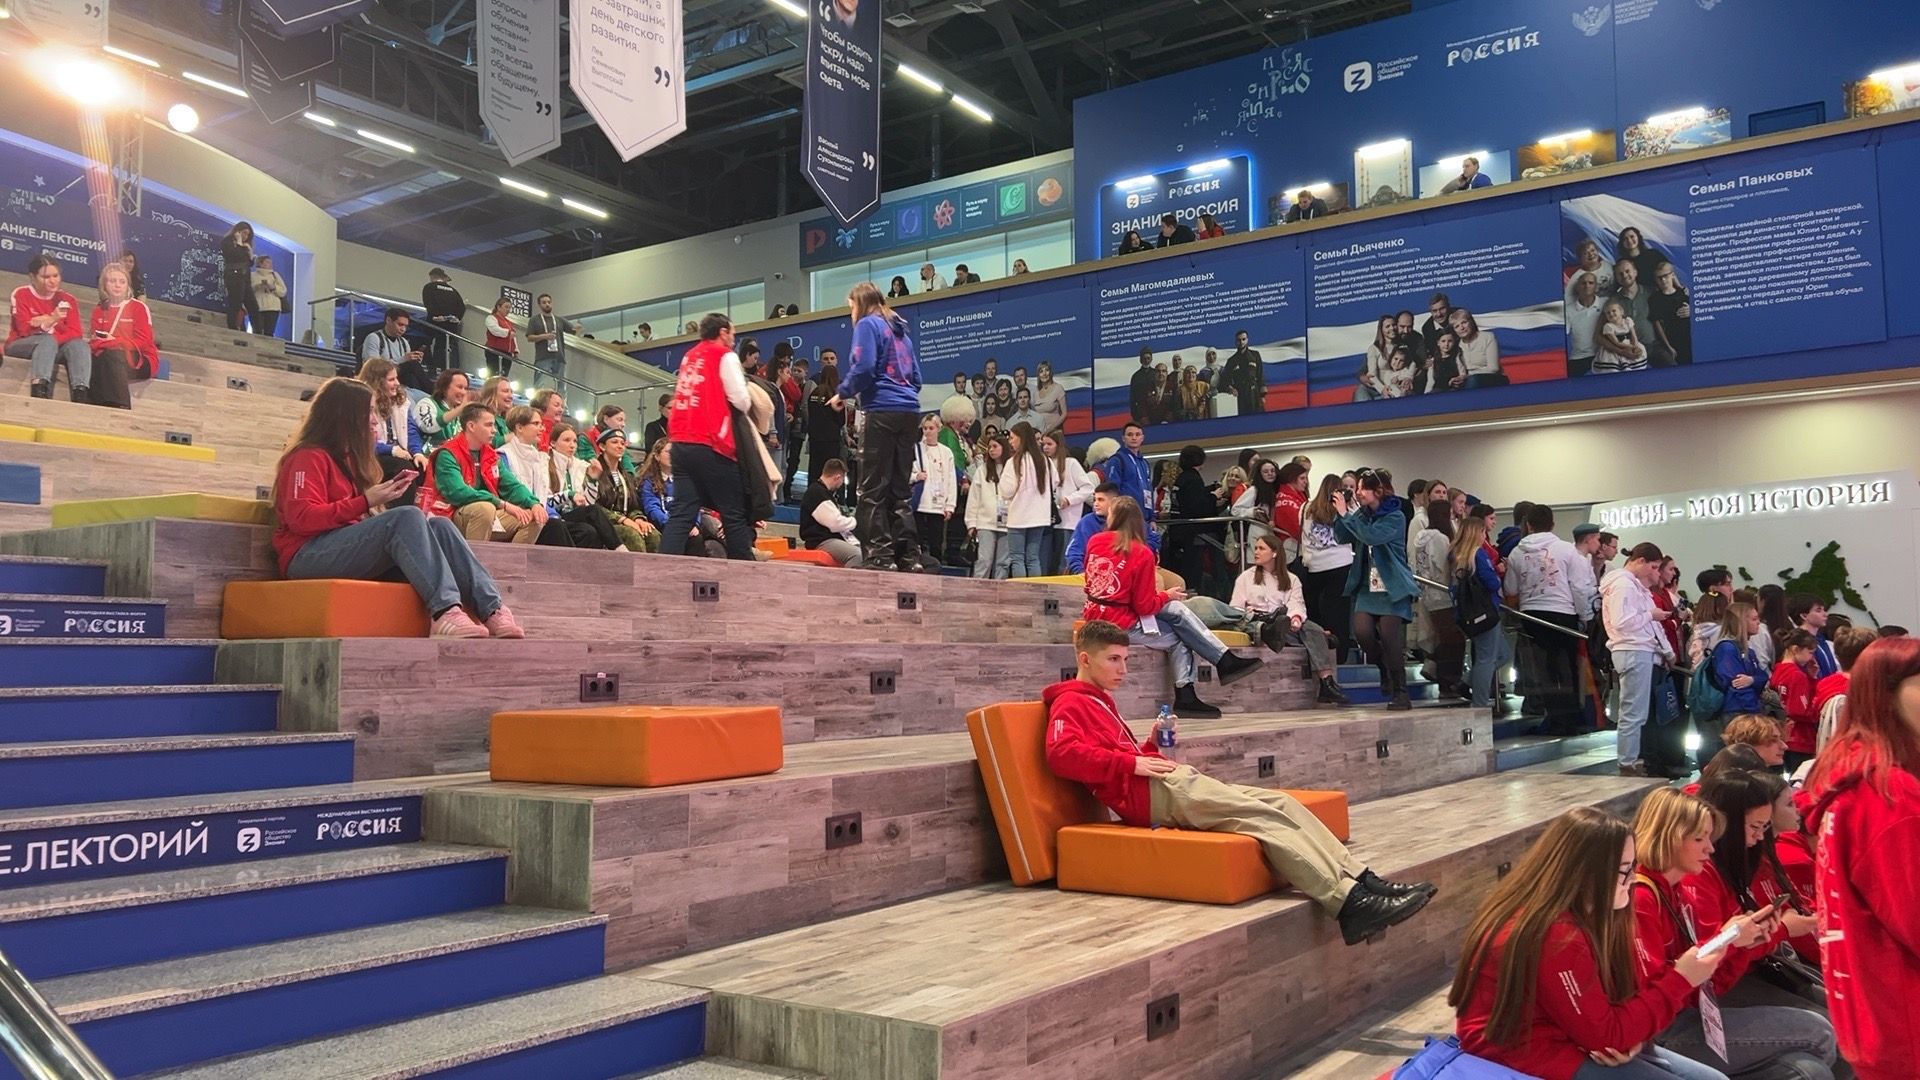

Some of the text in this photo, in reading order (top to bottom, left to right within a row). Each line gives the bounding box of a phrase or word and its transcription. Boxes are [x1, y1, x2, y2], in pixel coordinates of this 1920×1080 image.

[590, 6, 664, 44] день детского
[591, 24, 640, 53] развития.
[1446, 31, 1540, 67] РОССИЯ
[846, 42, 873, 63] родить
[846, 56, 865, 72] надо
[1377, 54, 1419, 69] Российское
[851, 73, 870, 90] море
[1168, 179, 1220, 199] РОССИЯ
[1689, 166, 1813, 196] Семья Панковых
[1175, 198, 1239, 223] РОССИЯ
[1313, 237, 1404, 260] Семья Дьяченко
[1100, 271, 1214, 298] Семья Магомедалиевых
[919, 311, 992, 328] Семья Латышевых
[1688, 495, 1740, 519] МОЯ
[1750, 481, 1890, 512] ИСТОРИЯ
[64, 618, 145, 633] РОССИЯ
[265, 828, 297, 836] Российское
[316, 816, 403, 841] РОССИЯ
[0, 820, 209, 875] Е.ЛЕКТОРИЙ
